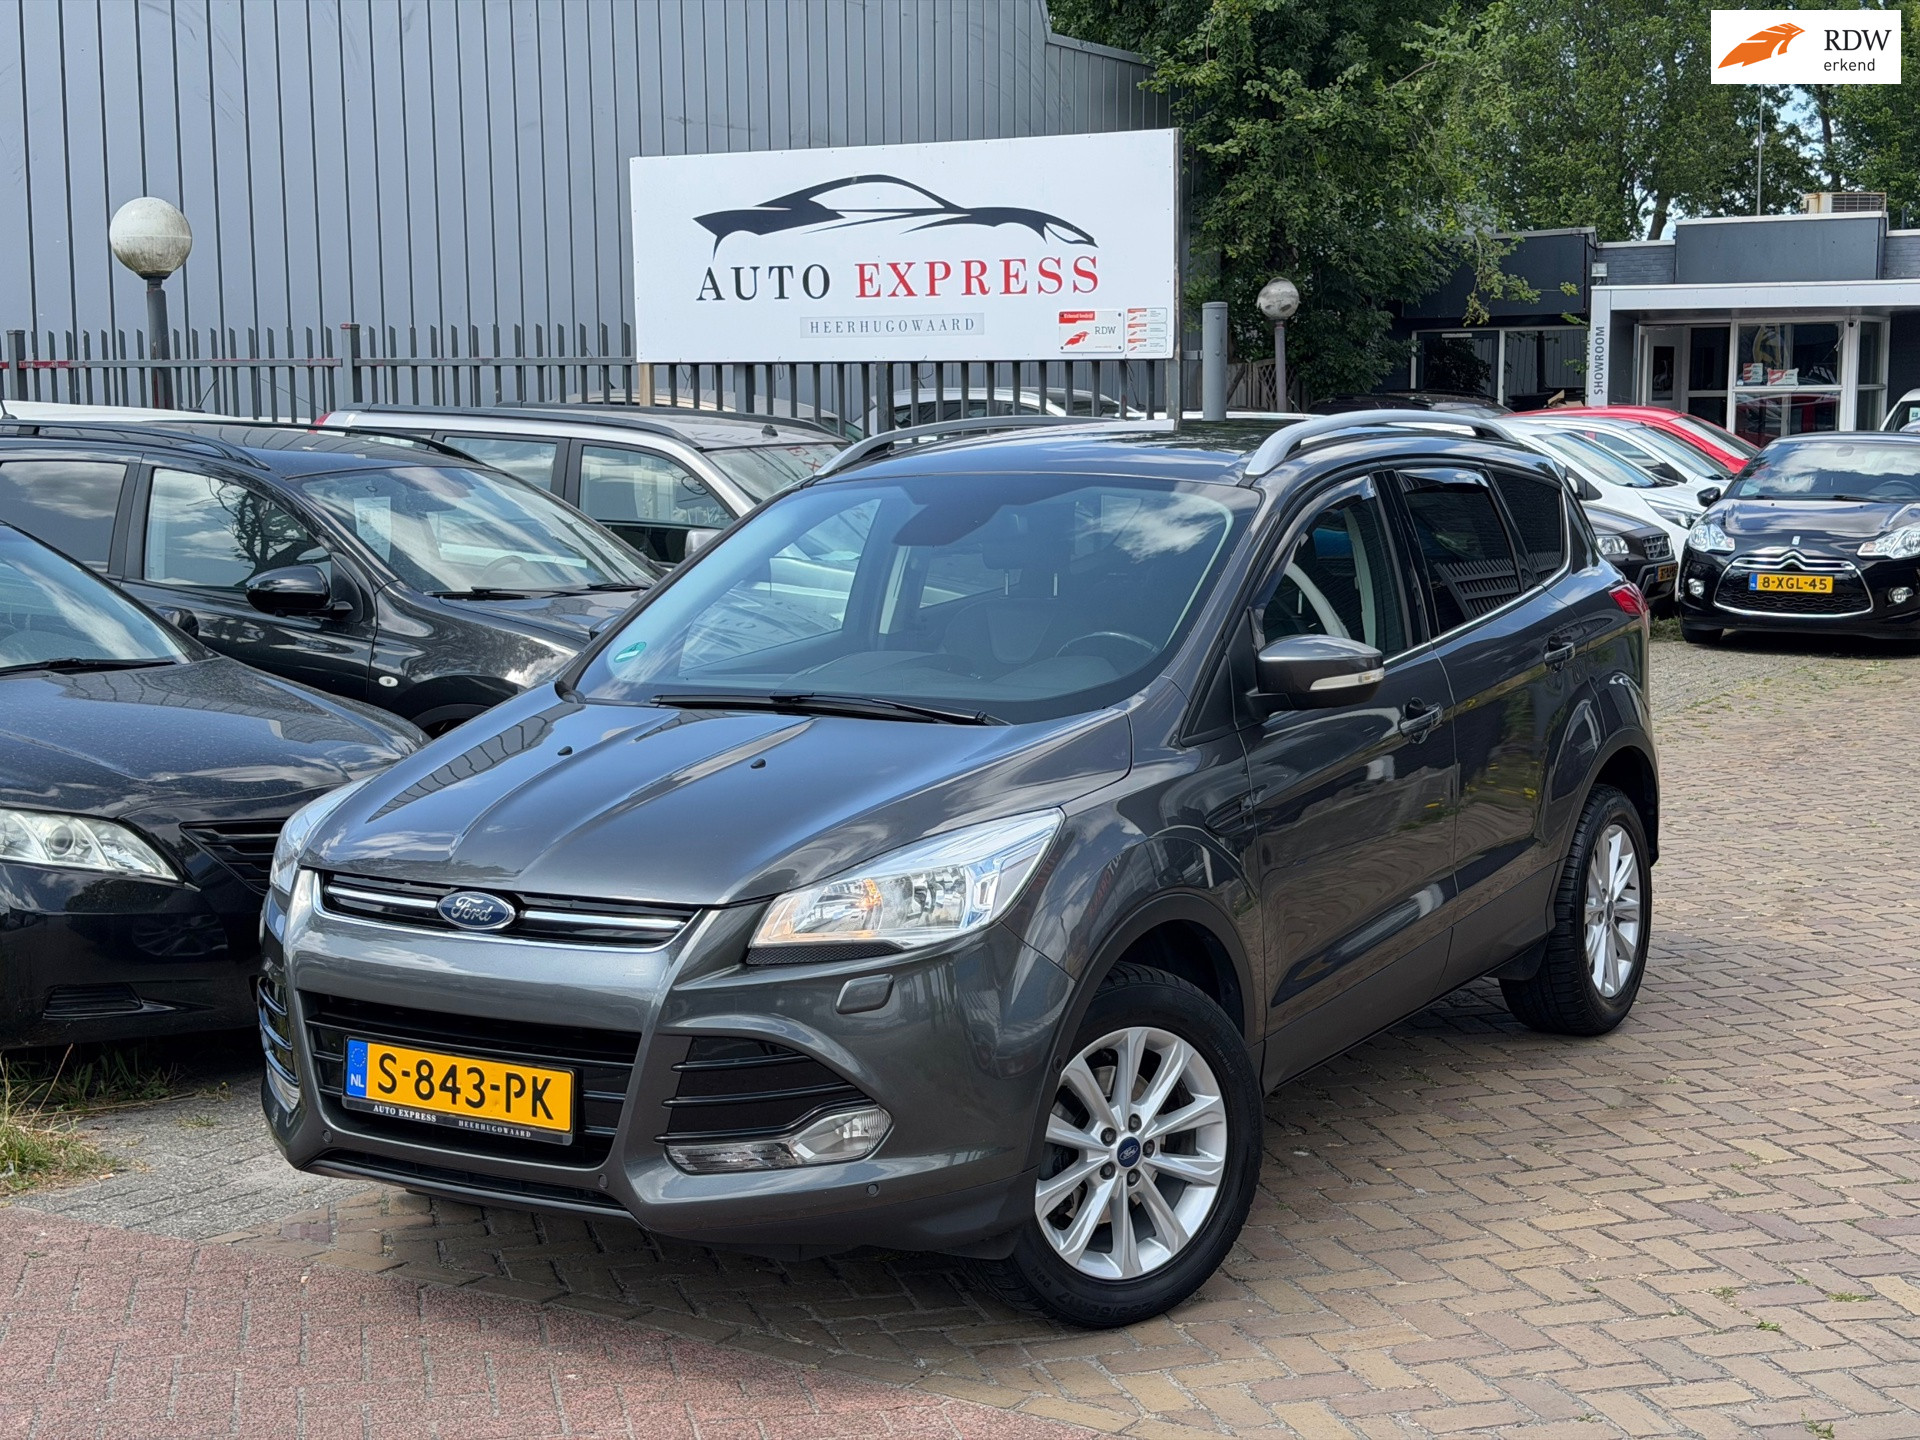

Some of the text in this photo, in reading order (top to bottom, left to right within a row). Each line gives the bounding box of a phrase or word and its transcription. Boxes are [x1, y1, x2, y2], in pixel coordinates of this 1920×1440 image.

[696, 256, 1098, 301] AUTO EXPRESS
[810, 318, 974, 333] HEERHUGOWAARD
[1095, 326, 1116, 335] RDW
[1594, 326, 1605, 395] SHOWROOM
[1762, 576, 1828, 591] 8-XGL-45
[451, 896, 493, 922] Ford
[350, 1073, 365, 1088] NL
[377, 1053, 554, 1120] S-843-PK
[373, 1104, 437, 1123] AUTO EXPRESS
[458, 1120, 531, 1138] HEERHUGOWAARD
